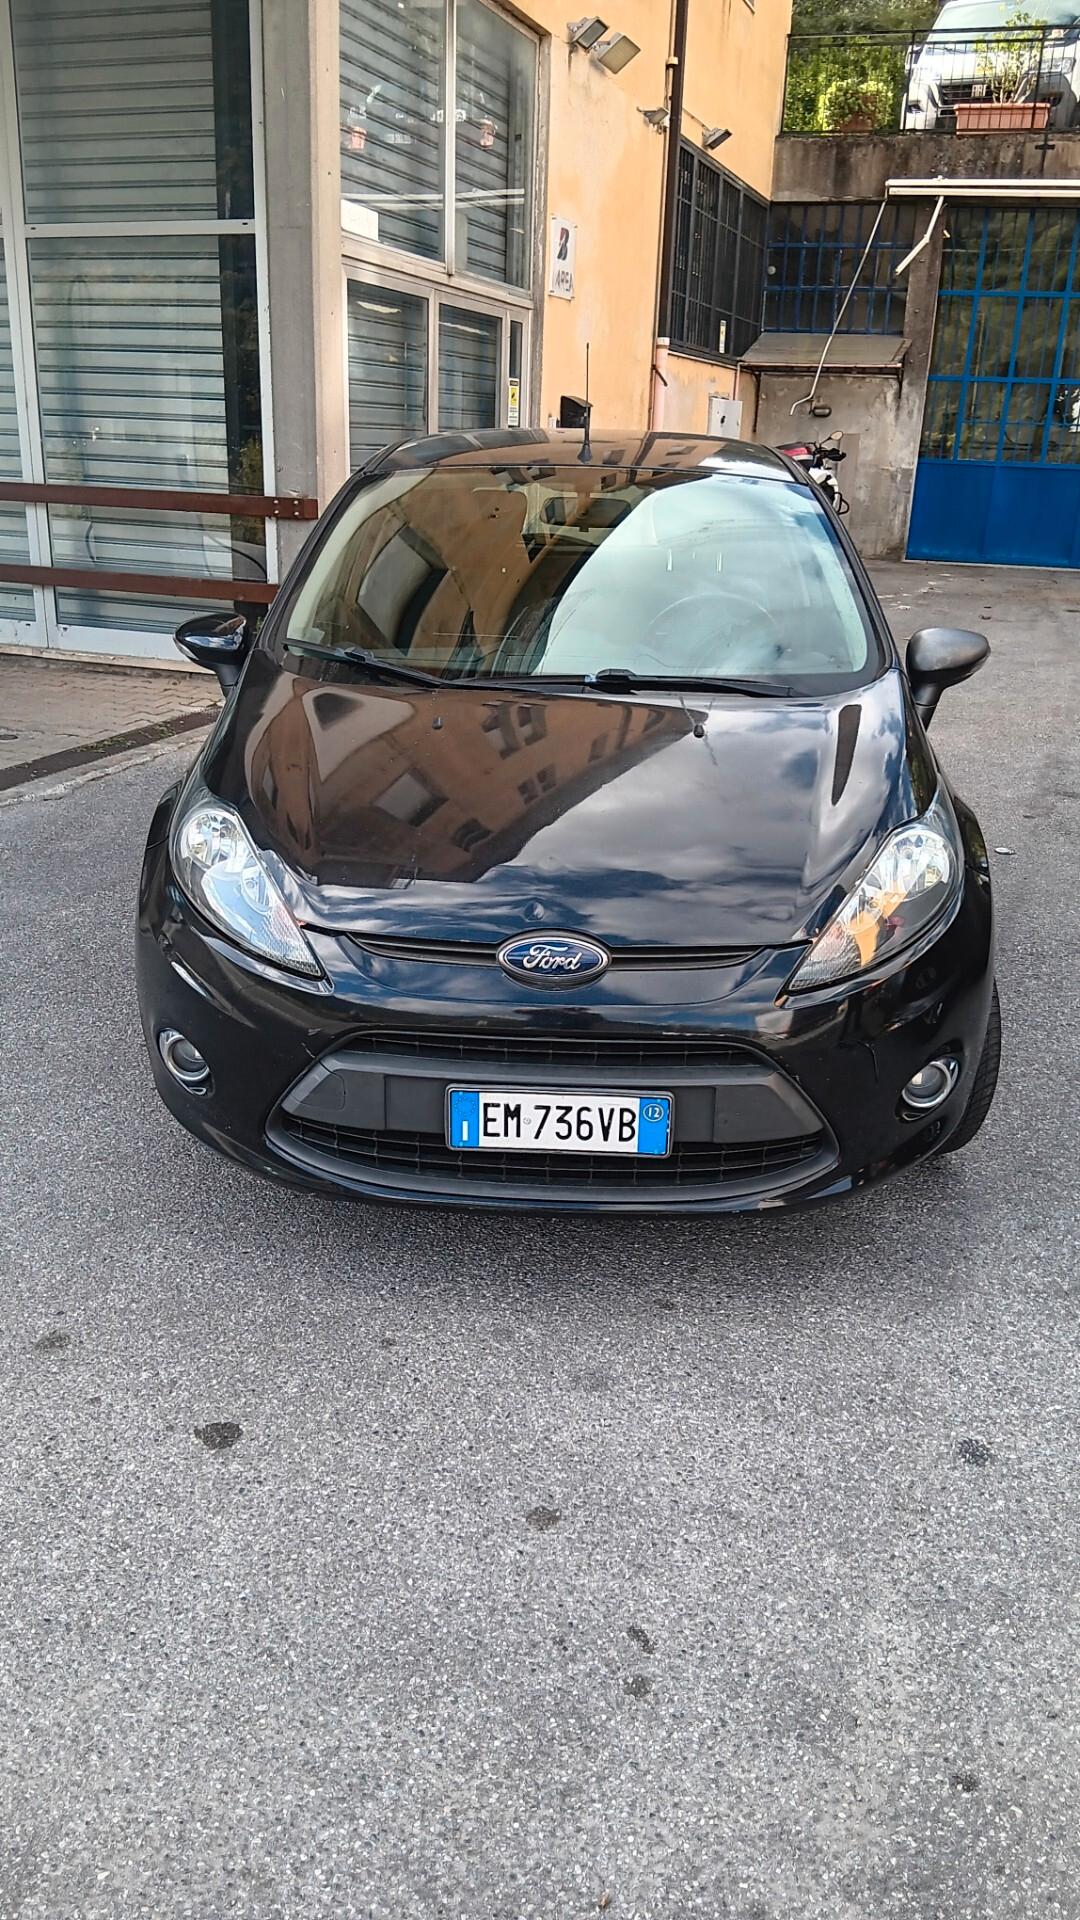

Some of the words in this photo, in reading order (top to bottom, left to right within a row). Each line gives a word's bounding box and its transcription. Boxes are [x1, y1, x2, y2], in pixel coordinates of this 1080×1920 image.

[523, 944, 582, 970] Ford
[483, 1102, 521, 1138] EM
[647, 1107, 662, 1119] 12
